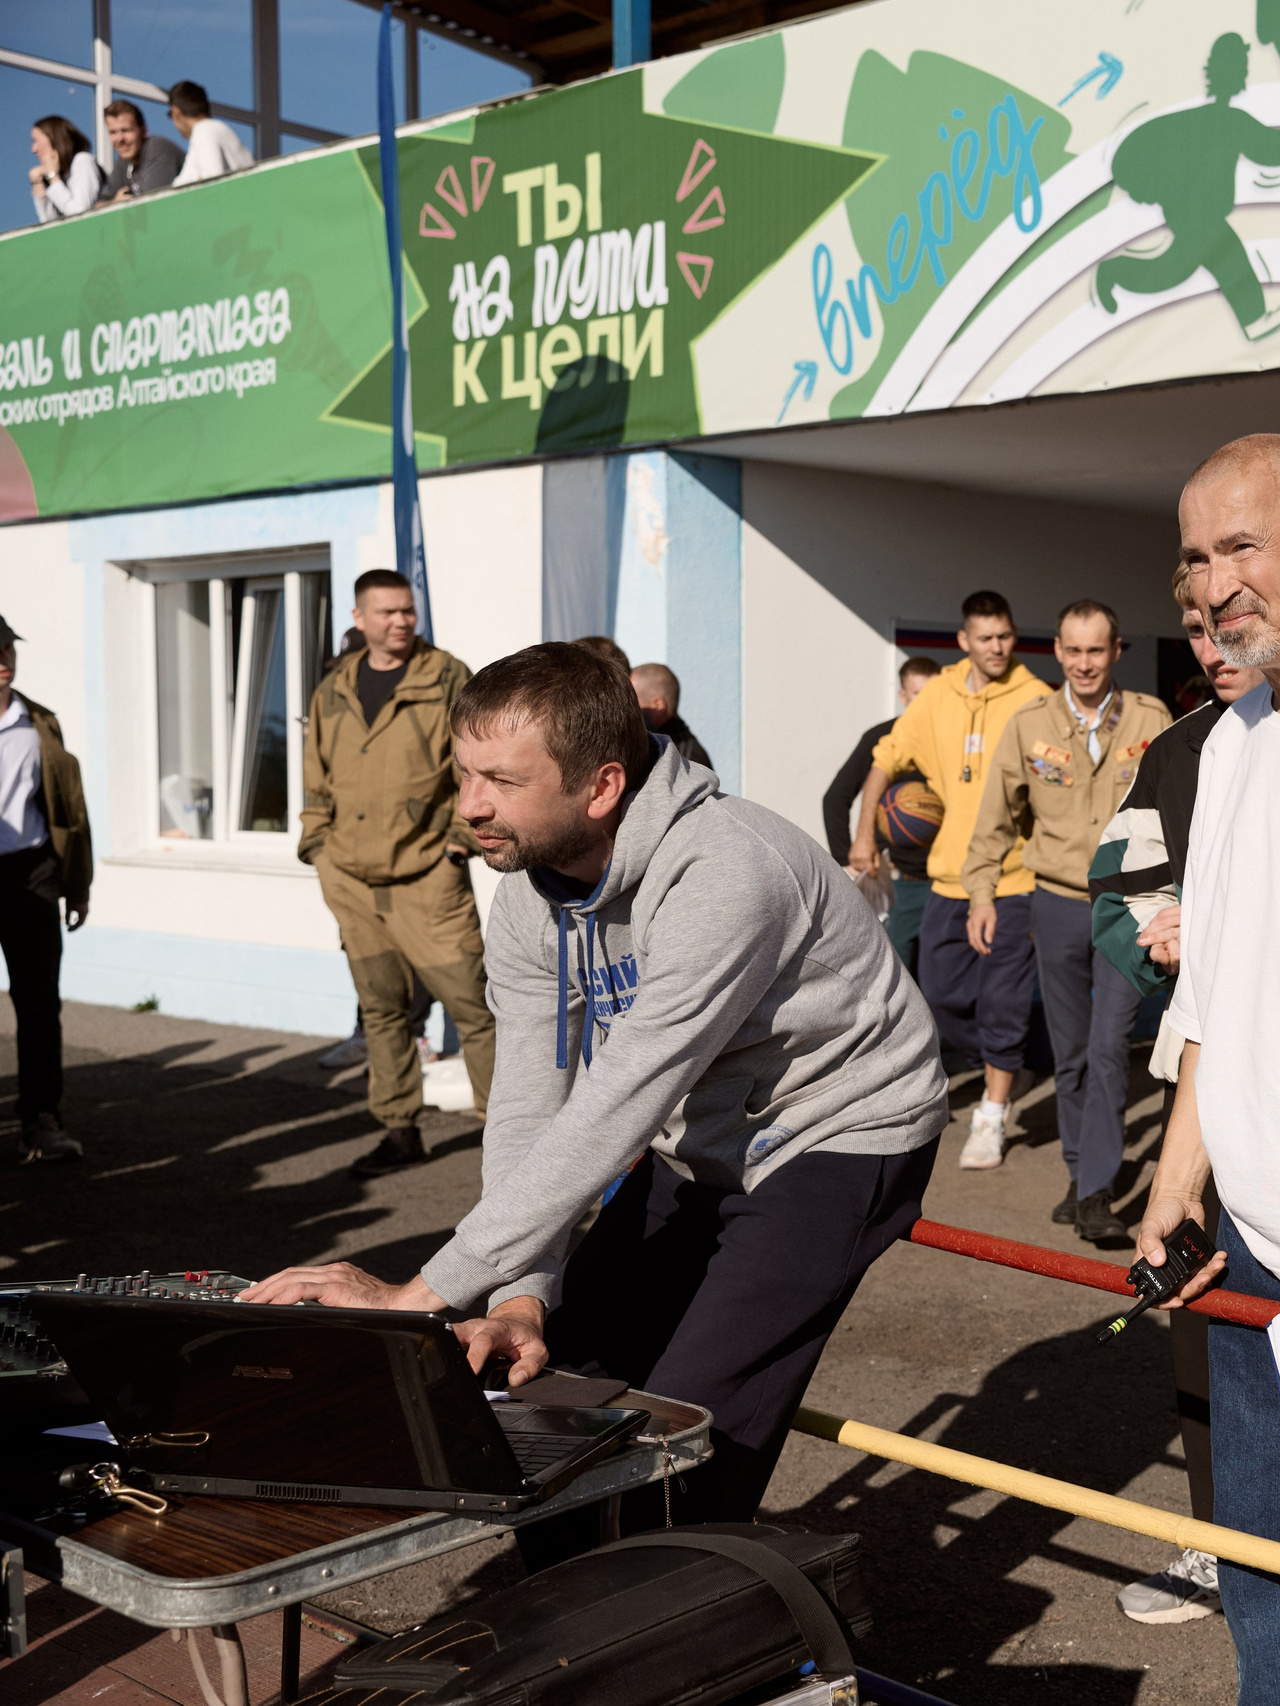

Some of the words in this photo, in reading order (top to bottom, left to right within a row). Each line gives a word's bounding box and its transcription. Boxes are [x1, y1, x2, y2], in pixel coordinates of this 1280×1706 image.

[811, 93, 1046, 376] вперёд
[448, 254, 514, 341] на
[531, 220, 669, 328] пути
[116, 367, 225, 409] Алтайского
[225, 356, 277, 399] края
[1146, 1270, 1163, 1291] VECTOR
